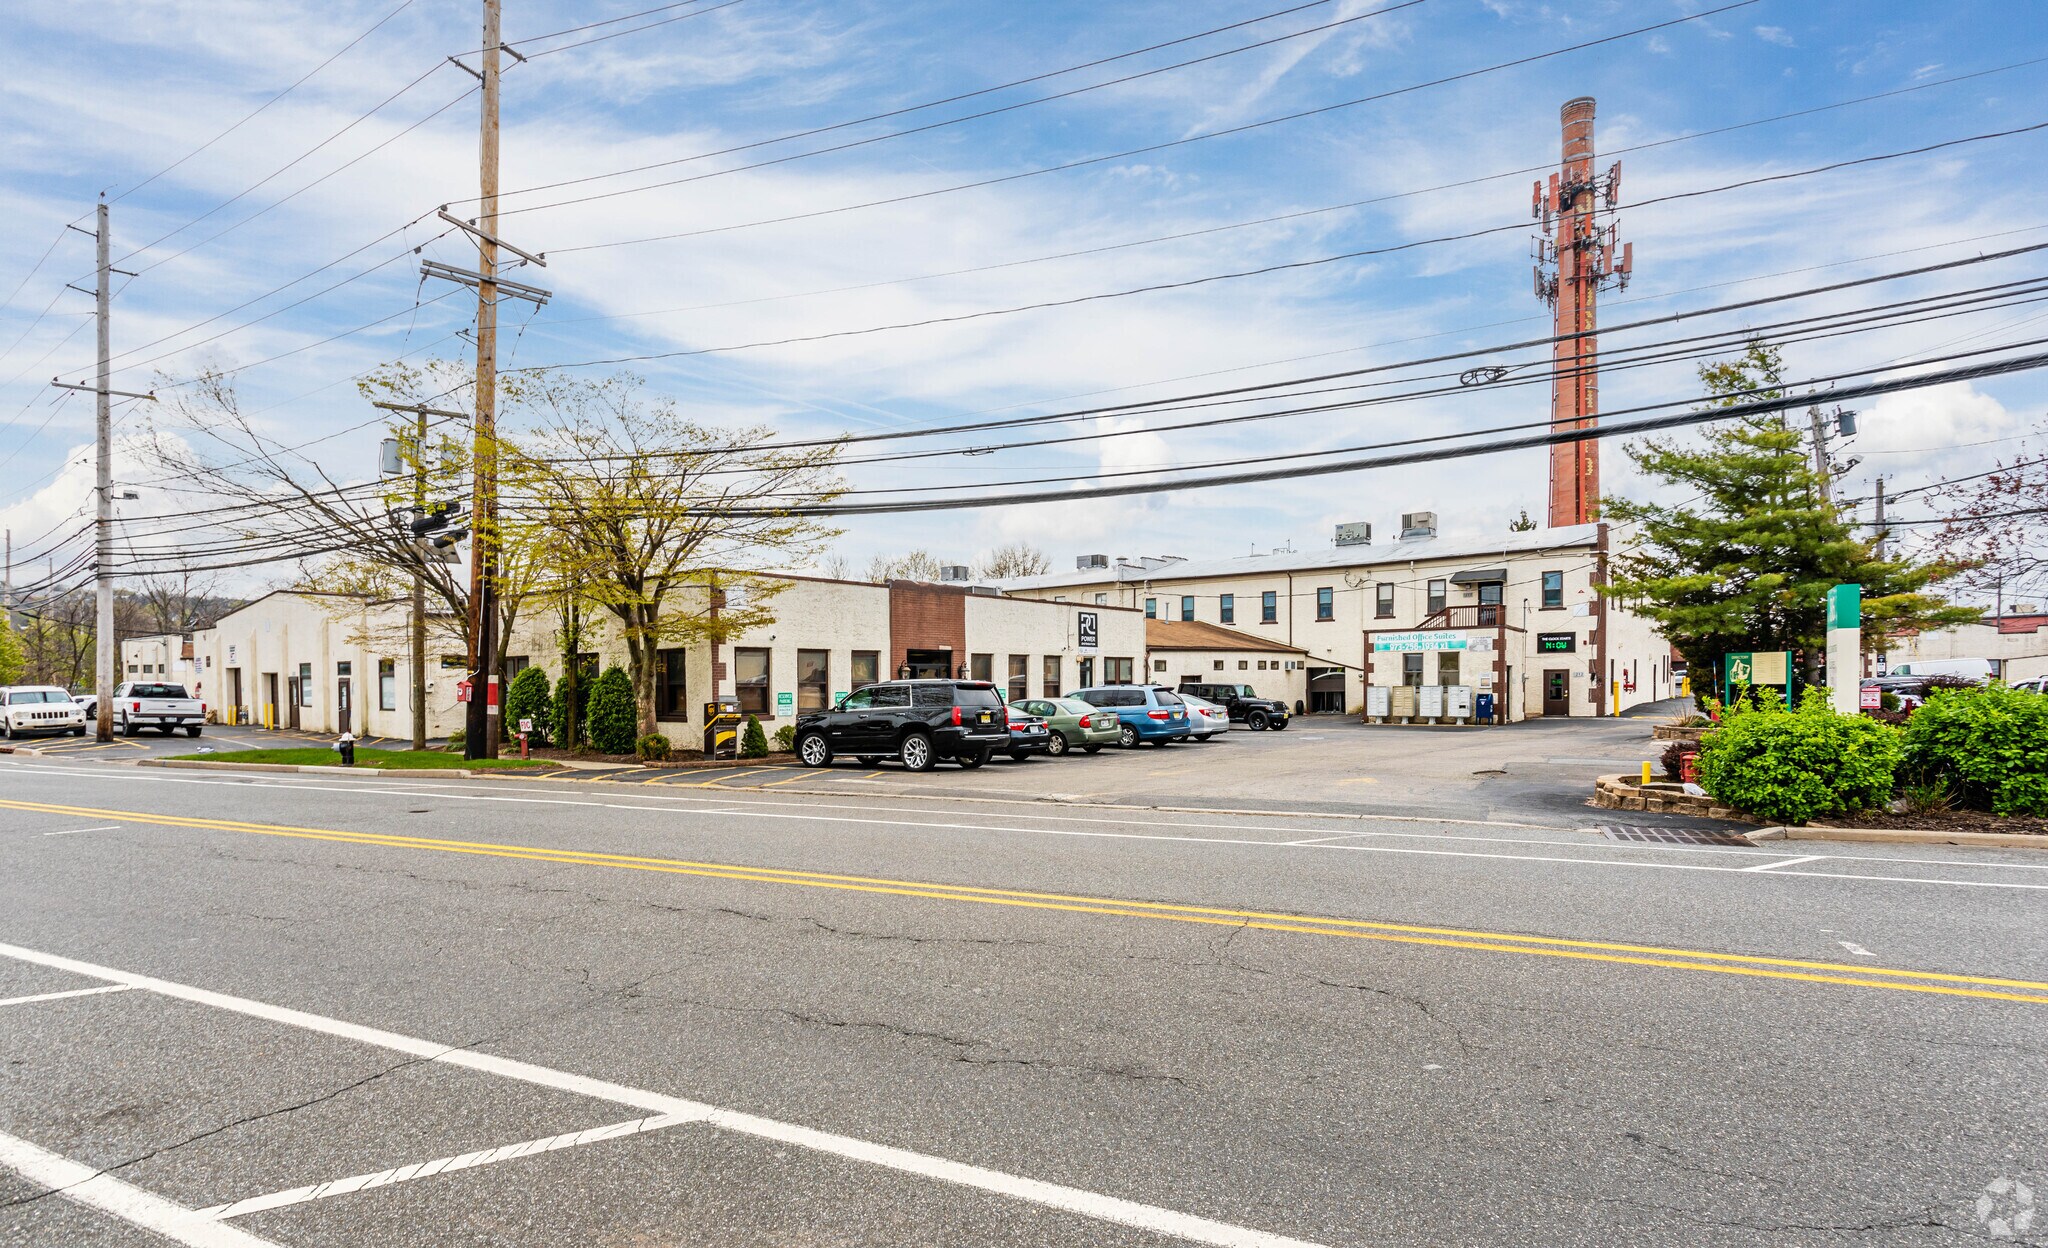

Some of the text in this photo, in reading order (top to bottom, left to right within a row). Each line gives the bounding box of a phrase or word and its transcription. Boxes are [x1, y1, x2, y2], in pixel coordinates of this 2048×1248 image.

[1376, 632, 1456, 642] Furnished Office Suites
